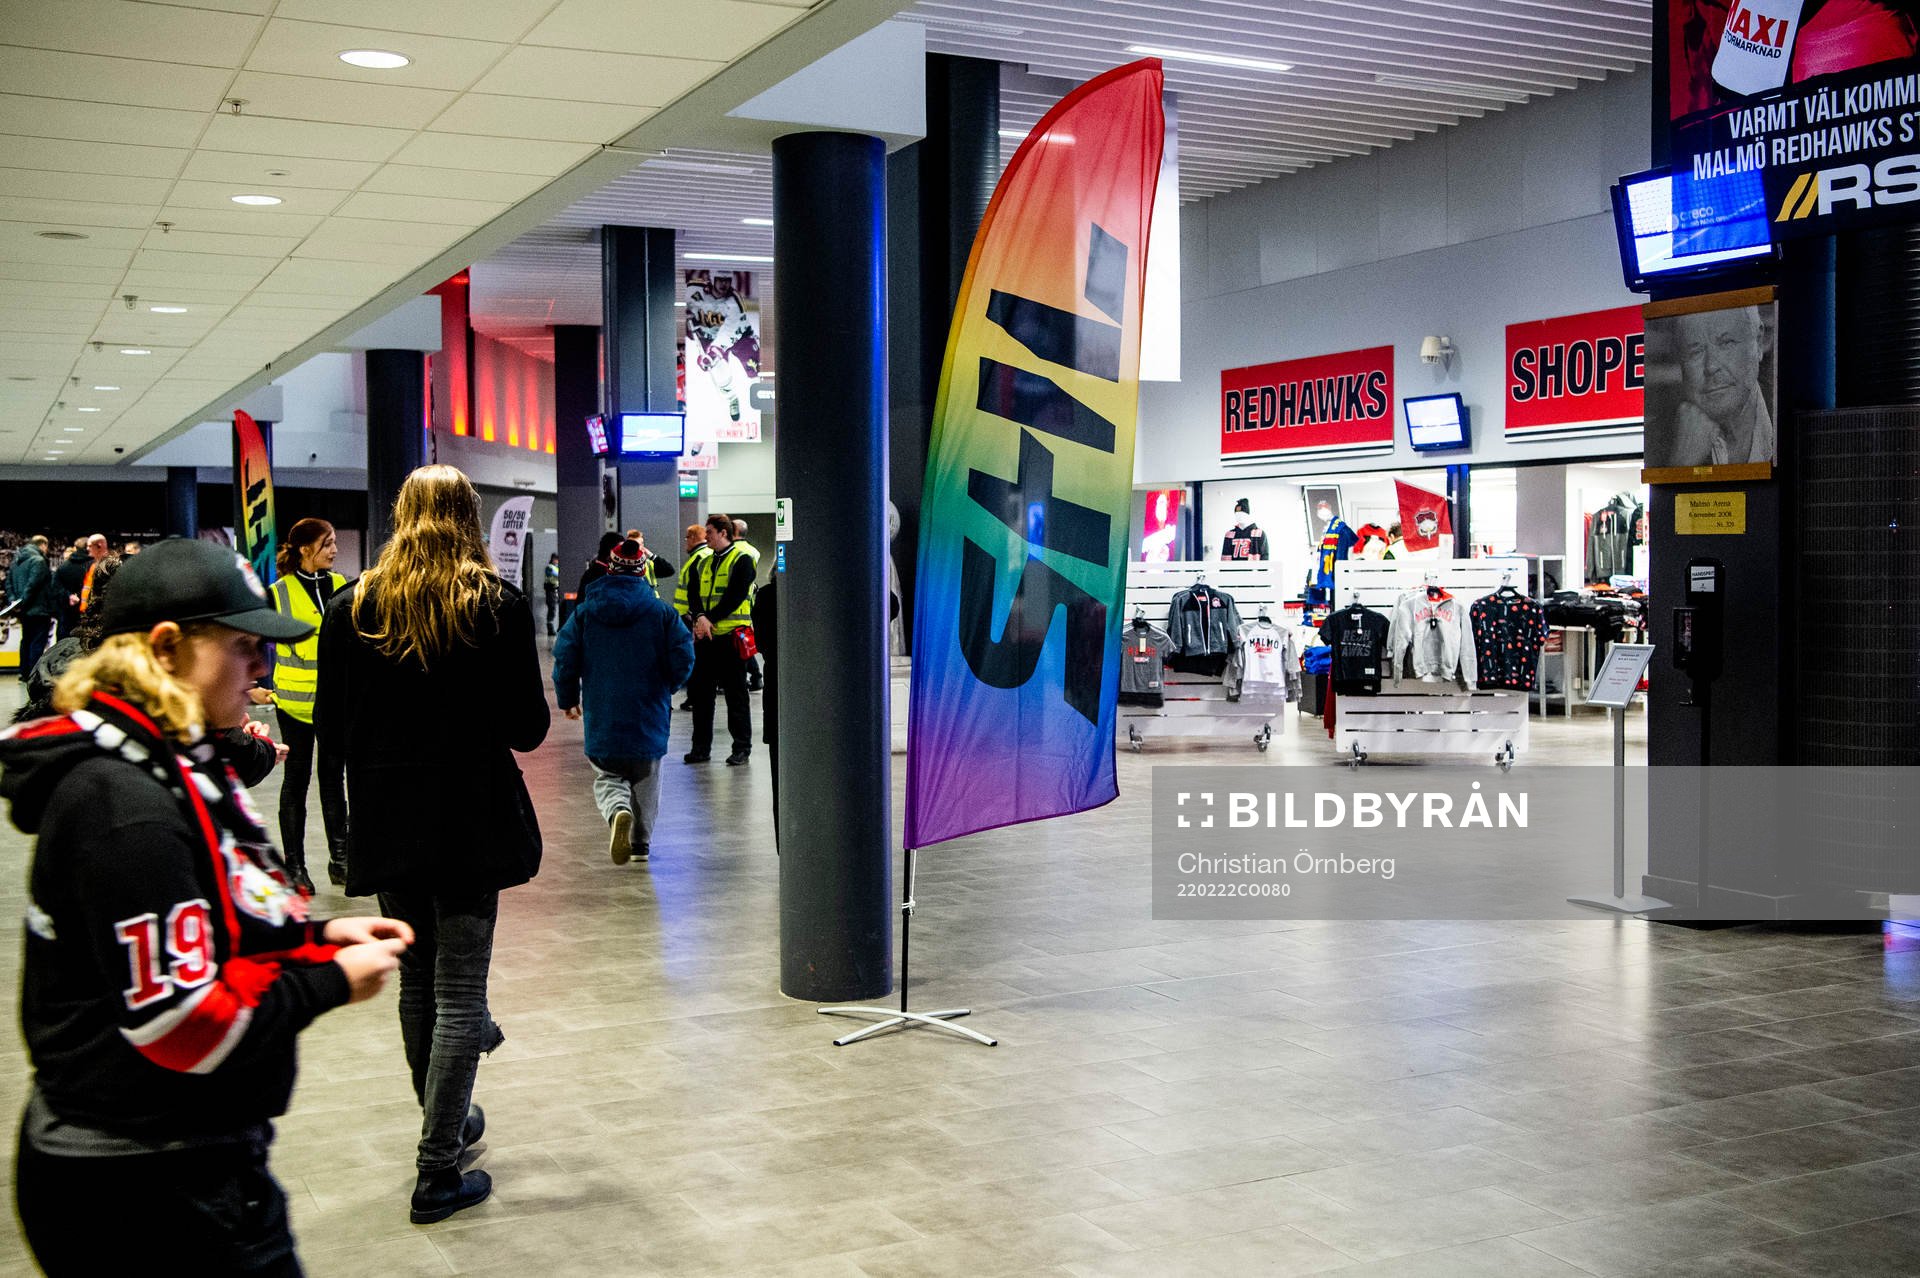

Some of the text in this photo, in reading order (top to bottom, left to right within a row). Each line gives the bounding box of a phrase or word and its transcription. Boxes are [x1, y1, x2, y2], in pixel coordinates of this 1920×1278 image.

[1728, 72, 1920, 139] VARMT VÄLKOMM
[1693, 136, 1766, 181] MALMÖ
[1772, 116, 1893, 167] REDHAWKS
[1512, 332, 1645, 403] SHOPE
[1225, 370, 1388, 433] REDHAWKS
[503, 509, 526, 521] 50/50
[113, 898, 219, 1011] 19
